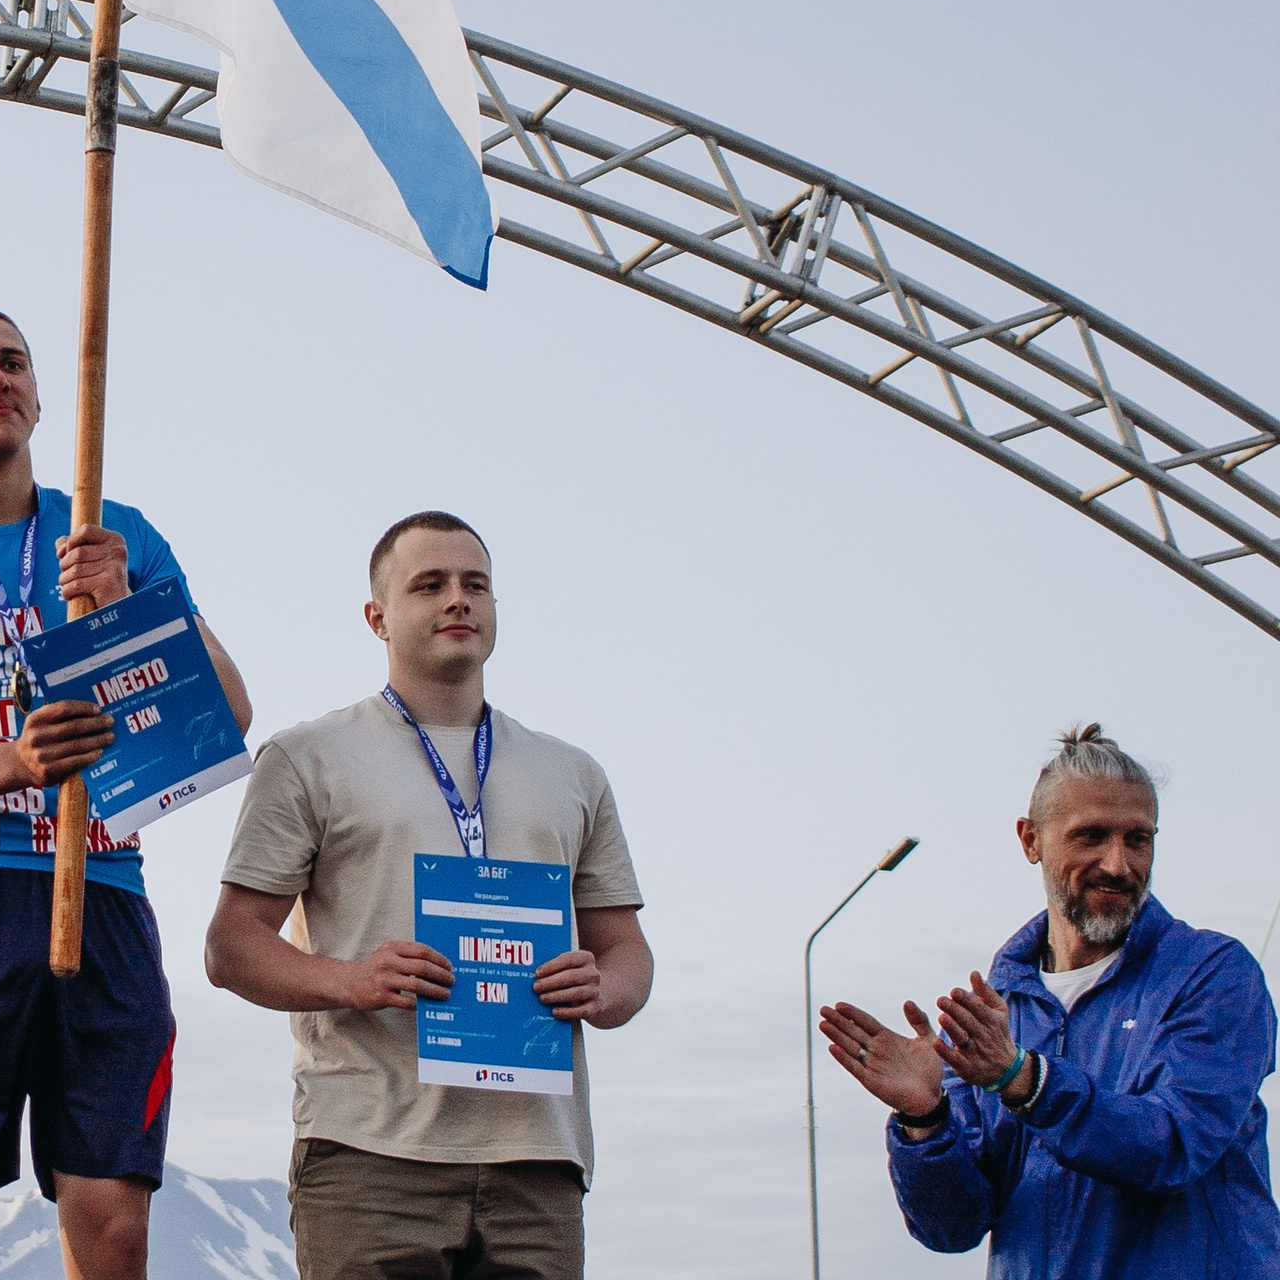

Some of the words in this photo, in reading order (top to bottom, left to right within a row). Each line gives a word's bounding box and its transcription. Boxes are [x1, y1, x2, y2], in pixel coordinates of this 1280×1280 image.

[101, 658, 169, 704] МЕСТО
[125, 713, 139, 734] 5
[136, 704, 162, 730] КМ
[172, 783, 197, 801] ПСБ
[477, 937, 534, 966] МЕСТО
[476, 981, 486, 1002] 5
[487, 982, 509, 1004] КМ
[491, 1072, 515, 1082] ПСБ
